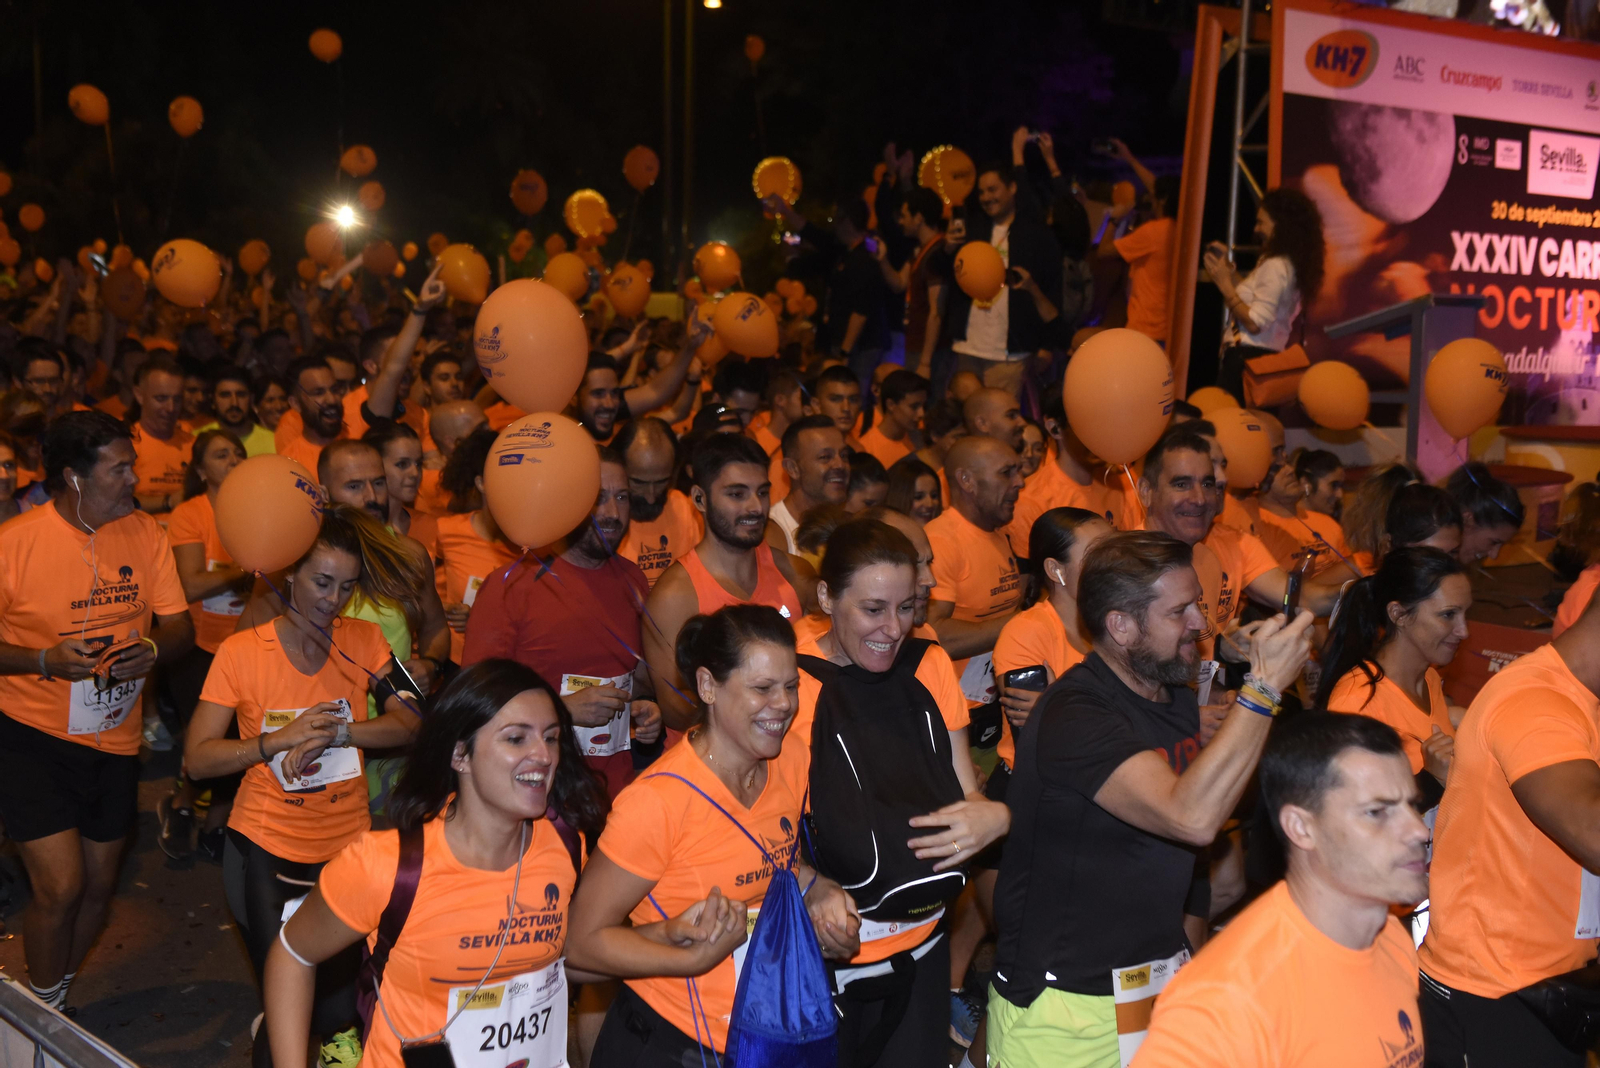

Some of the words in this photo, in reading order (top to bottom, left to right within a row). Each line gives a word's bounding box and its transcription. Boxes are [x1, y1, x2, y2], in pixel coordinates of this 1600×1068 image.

[1392, 55, 1425, 77] ABC
[1440, 65, 1502, 92] Cruzcampo
[1540, 83, 1574, 99] SEVILLA
[1491, 200, 1508, 220] 30
[1508, 202, 1525, 222] de
[1525, 204, 1593, 228] septiembre
[1450, 230, 1539, 276] XXXIV
[638, 552, 672, 562] NOCTURNA
[91, 583, 139, 597] NOCTURNA
[71, 595, 113, 610] SEVILLA
[498, 912, 562, 931] NOCTURNA
[459, 932, 531, 949] SEVILLA
[479, 1005, 553, 1053] 20437
